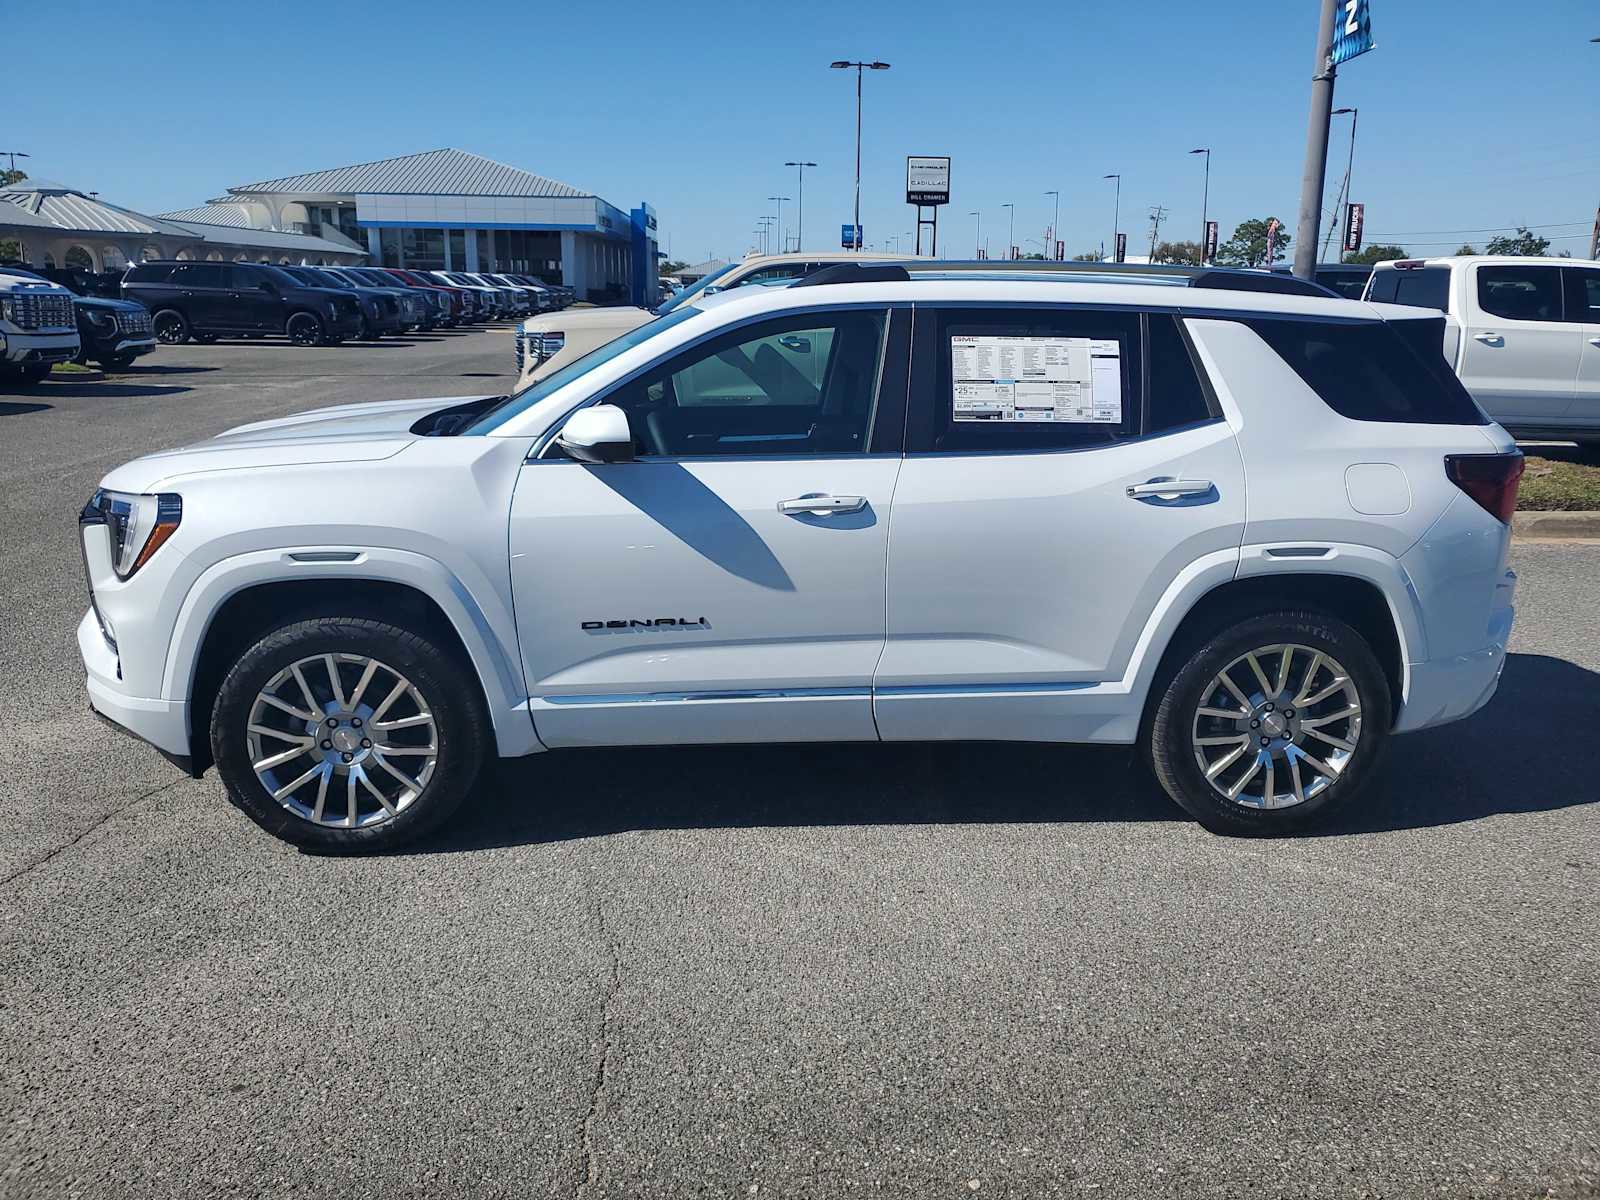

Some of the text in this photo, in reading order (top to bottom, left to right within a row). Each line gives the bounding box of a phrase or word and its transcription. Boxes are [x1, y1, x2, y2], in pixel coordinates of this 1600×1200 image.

[1349, 206, 1359, 249] NEW TRUCKS
[581, 617, 705, 630] DENALI
